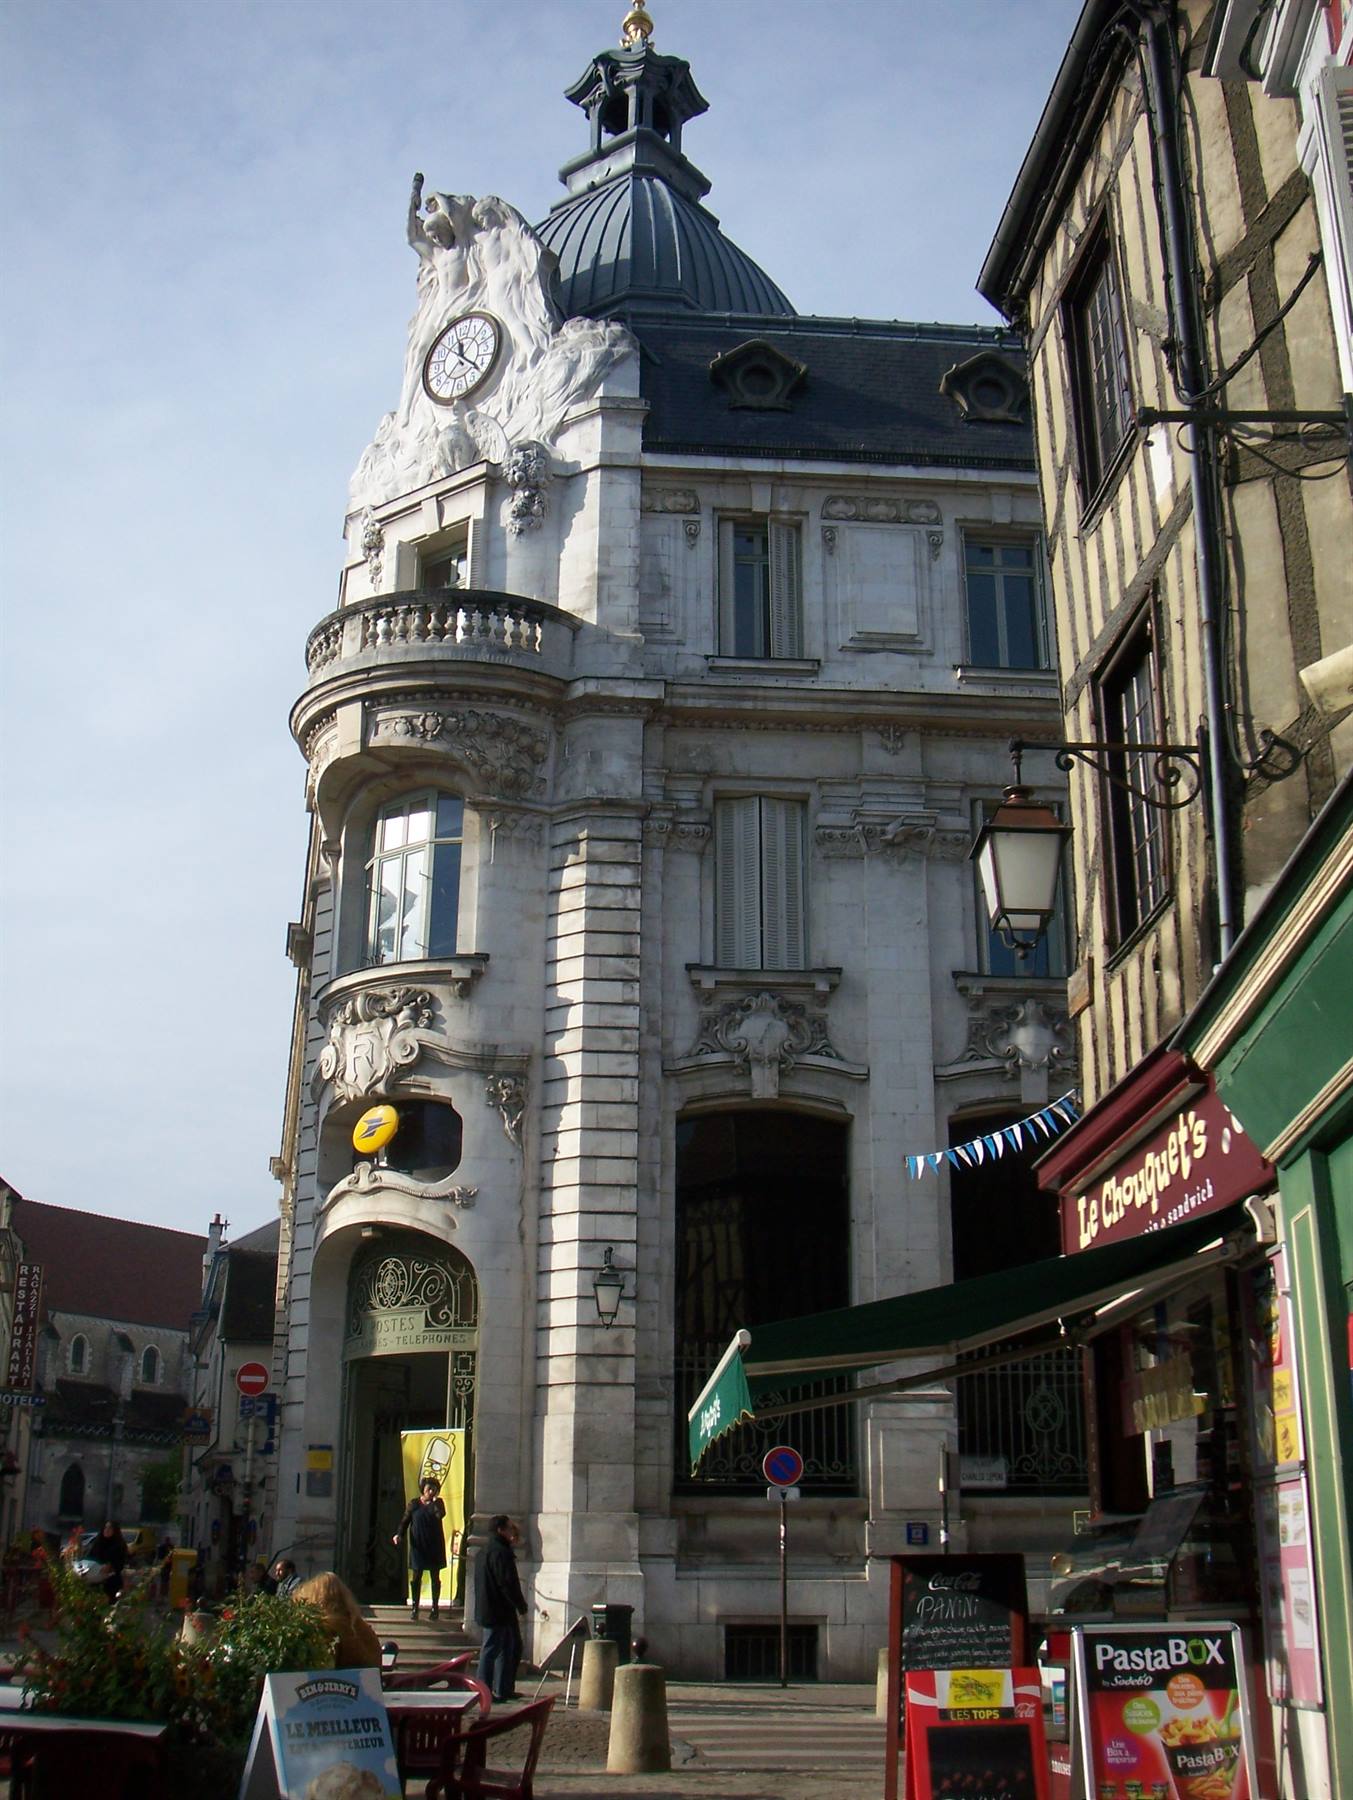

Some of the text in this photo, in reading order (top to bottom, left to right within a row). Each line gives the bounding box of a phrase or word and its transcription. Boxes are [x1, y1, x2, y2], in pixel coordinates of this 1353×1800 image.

[1077, 1110, 1208, 1250] Le Chouquet's
[1167, 1178, 1214, 1225] sandwich
[28, 1265, 41, 1319] RAGAZZI
[9, 1264, 29, 1386] RESTAURANT
[1095, 1638, 1225, 1672] PastaBOX
[287, 1717, 383, 1738] LE MEILLEUR
[949, 1709, 1001, 1721] LES TOPS
[1176, 1744, 1240, 1769] PastaBOX
